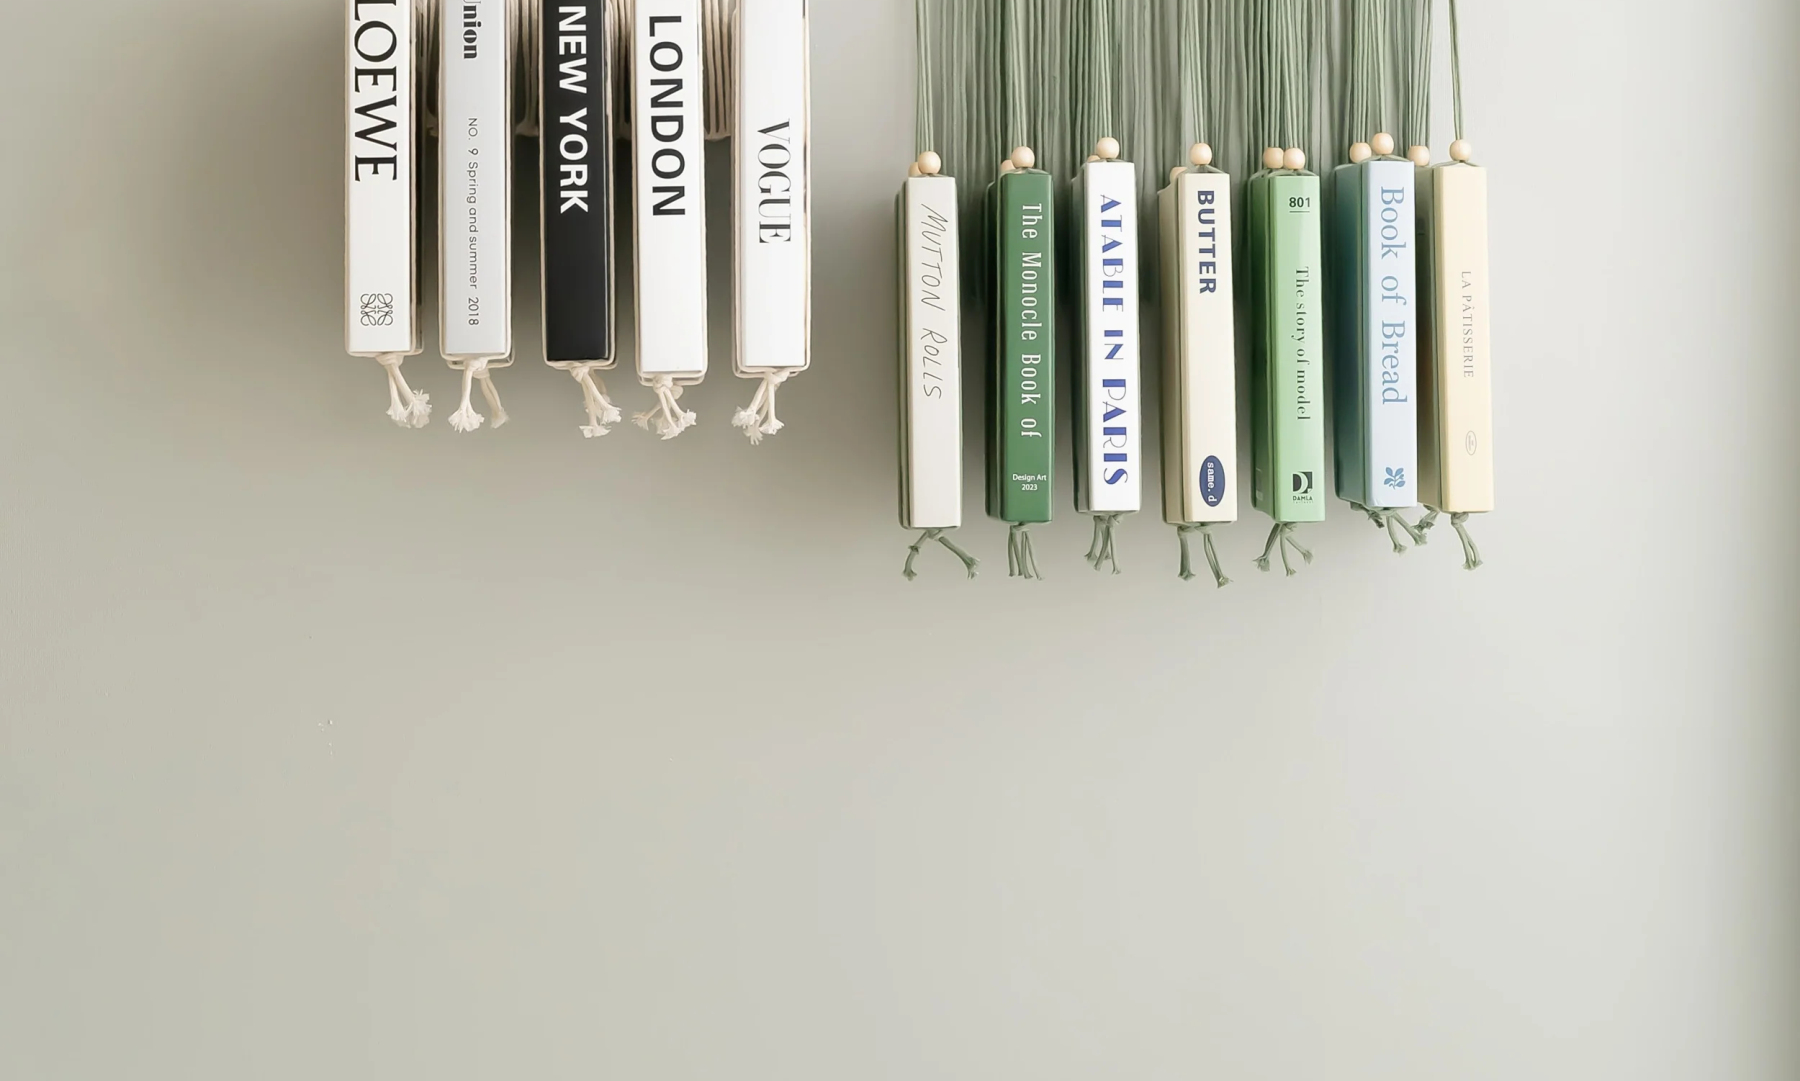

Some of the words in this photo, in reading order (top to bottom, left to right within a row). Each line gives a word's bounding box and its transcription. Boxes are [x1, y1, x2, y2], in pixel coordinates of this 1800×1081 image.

[559, 6, 587, 93] NEW
[467, 117, 478, 141] NO.
[649, 16, 685, 216] LONDON
[467, 147, 479, 156] 9
[560, 107, 588, 213] YORK
[467, 162, 478, 203] Spring
[758, 119, 791, 244] VOGUE
[468, 207, 479, 233] and
[1022, 203, 1042, 238] The
[1289, 197, 1310, 208] 801
[1381, 186, 1406, 259] Book
[468, 236, 478, 290] summer
[921, 204, 948, 311] MUTTON
[1198, 191, 1216, 294] BUTTER
[1022, 253, 1042, 340] Monocle
[1295, 266, 1309, 298] The
[1381, 276, 1407, 305] of
[1462, 272, 1471, 289] LA
[468, 297, 479, 325] 2018
[1291, 302, 1307, 343] story
[921, 327, 947, 400] ROLLS
[1104, 330, 1123, 359] IN
[1296, 348, 1310, 365] of
[1382, 320, 1407, 404] Bread
[1021, 354, 1041, 404] Book
[1297, 371, 1310, 419] model
[1021, 419, 1041, 437] of
[1102, 379, 1128, 485] PARIS
[1012, 473, 1035, 482] Design
[1021, 483, 1038, 491] 2023
